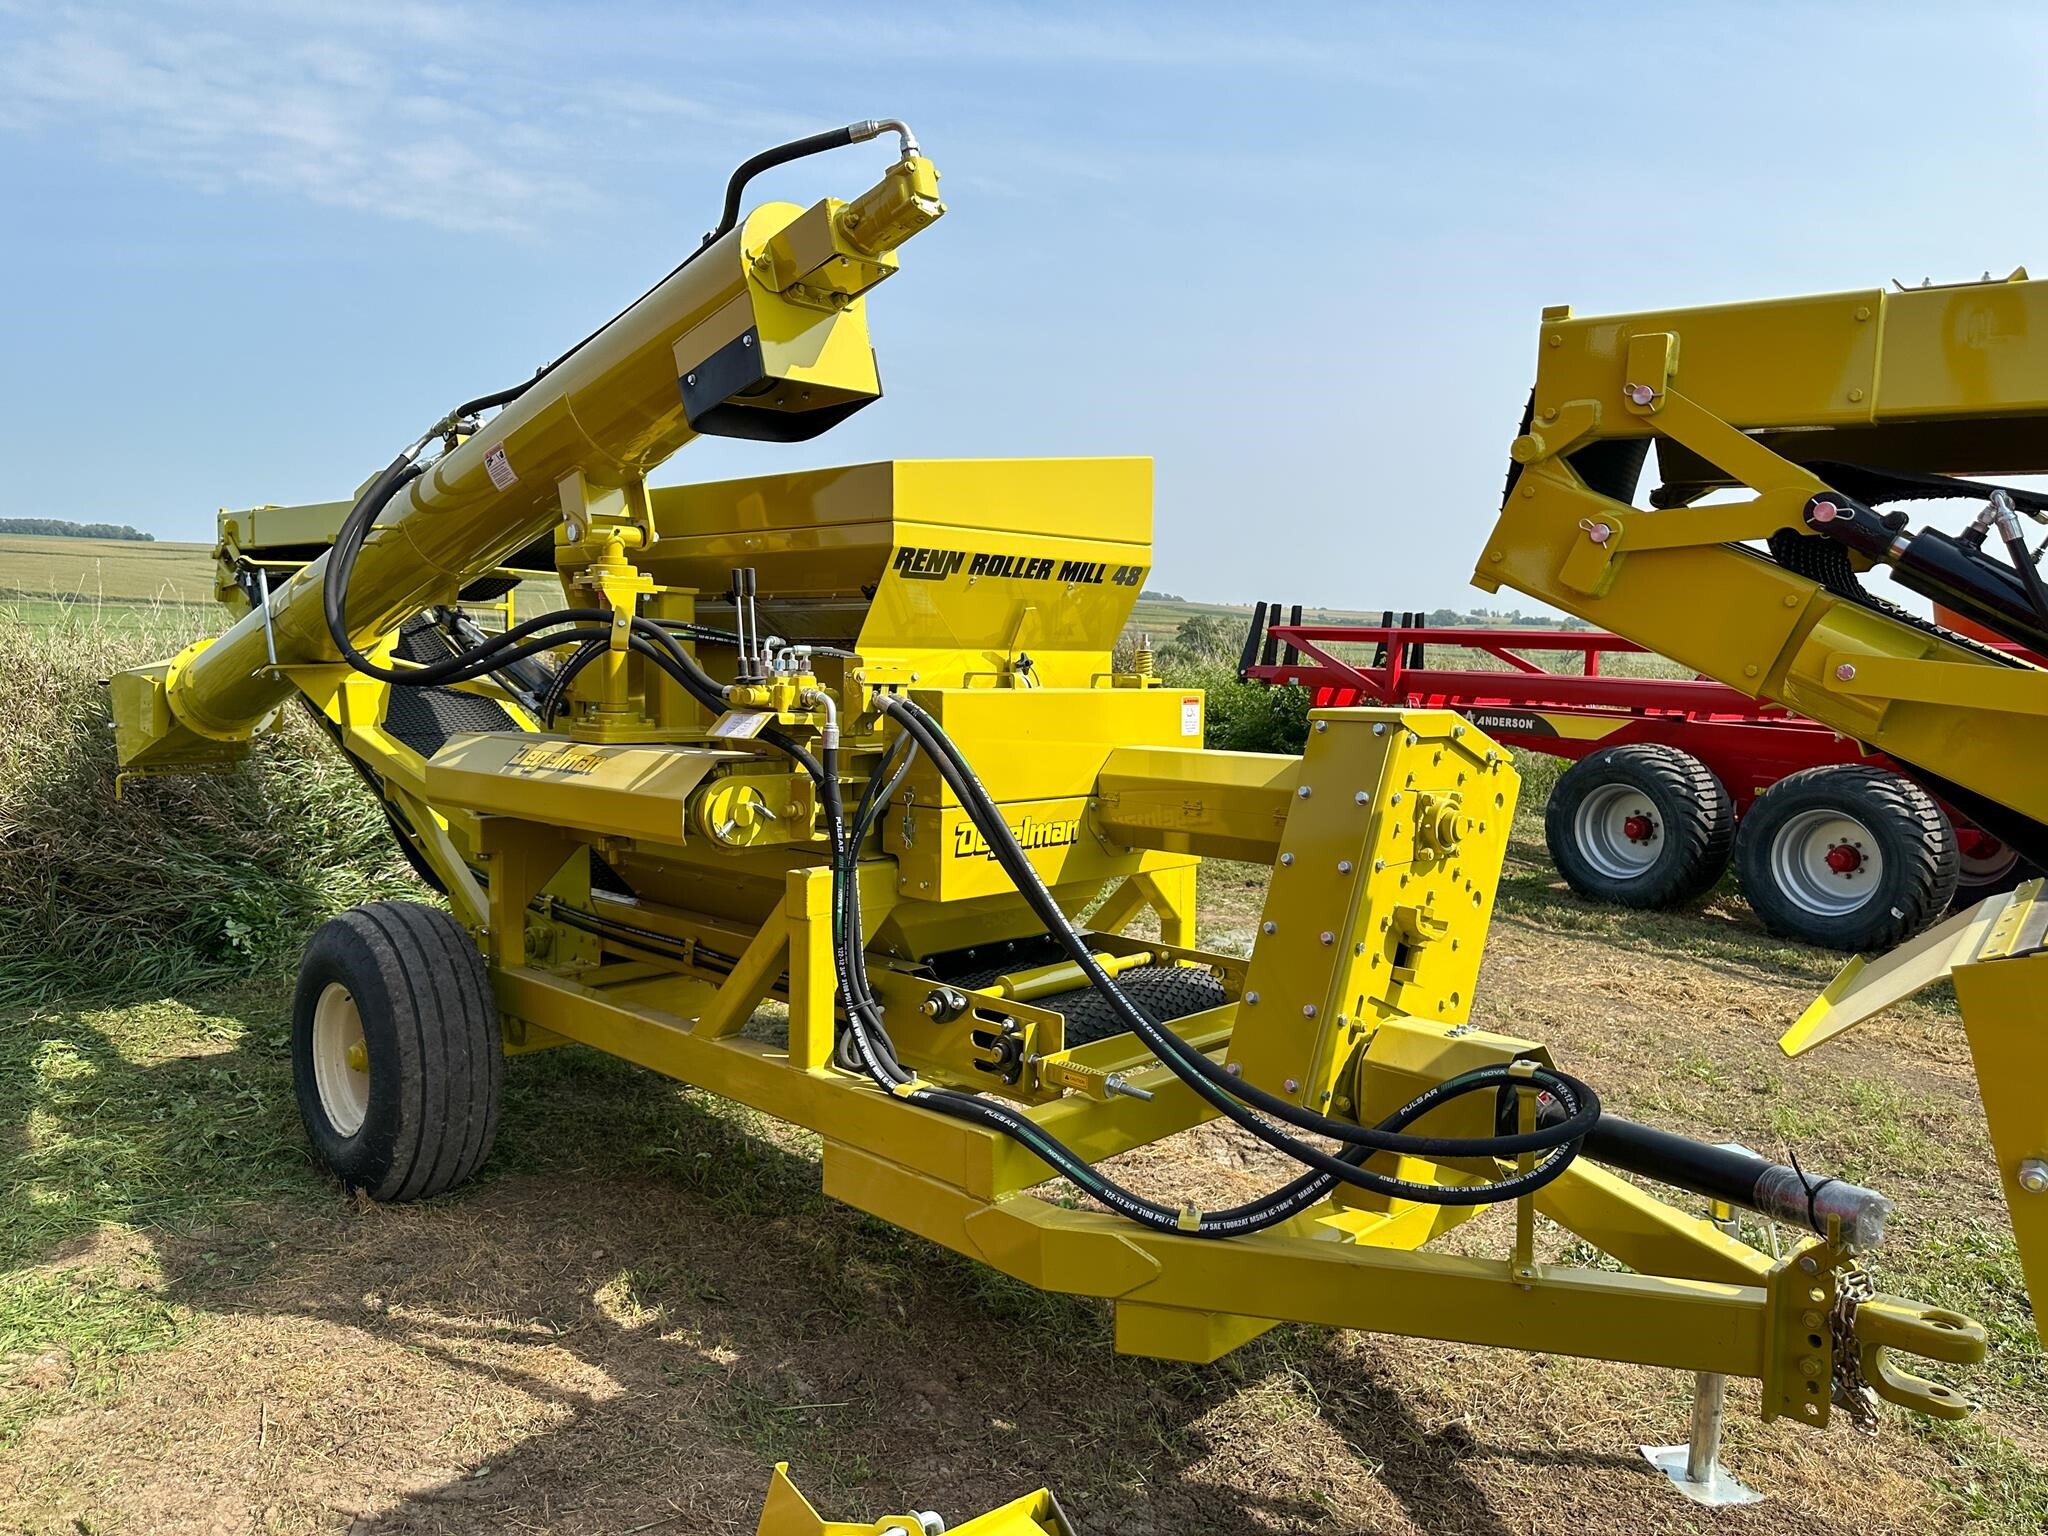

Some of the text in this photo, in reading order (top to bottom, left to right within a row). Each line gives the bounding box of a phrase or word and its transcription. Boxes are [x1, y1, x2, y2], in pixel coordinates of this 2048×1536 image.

[893, 547, 1144, 586] RENN ROLLER MILL 48
[1477, 715, 1534, 729] ANDERSON
[504, 743, 608, 775] Degelman
[835, 816, 845, 853] PULSAR
[1400, 1069, 1506, 1116] PULSAR NOVA
[985, 1109, 1018, 1128] PULSAR
[1047, 1149, 1067, 1165] NOVA
[1103, 1189, 1124, 1206] 122-12
[1137, 1207, 1154, 1220] 3100
[1154, 1214, 1165, 1223] PSI
[1209, 1222, 1221, 1230] SAE
[1297, 1185, 1315, 1200] MADE
